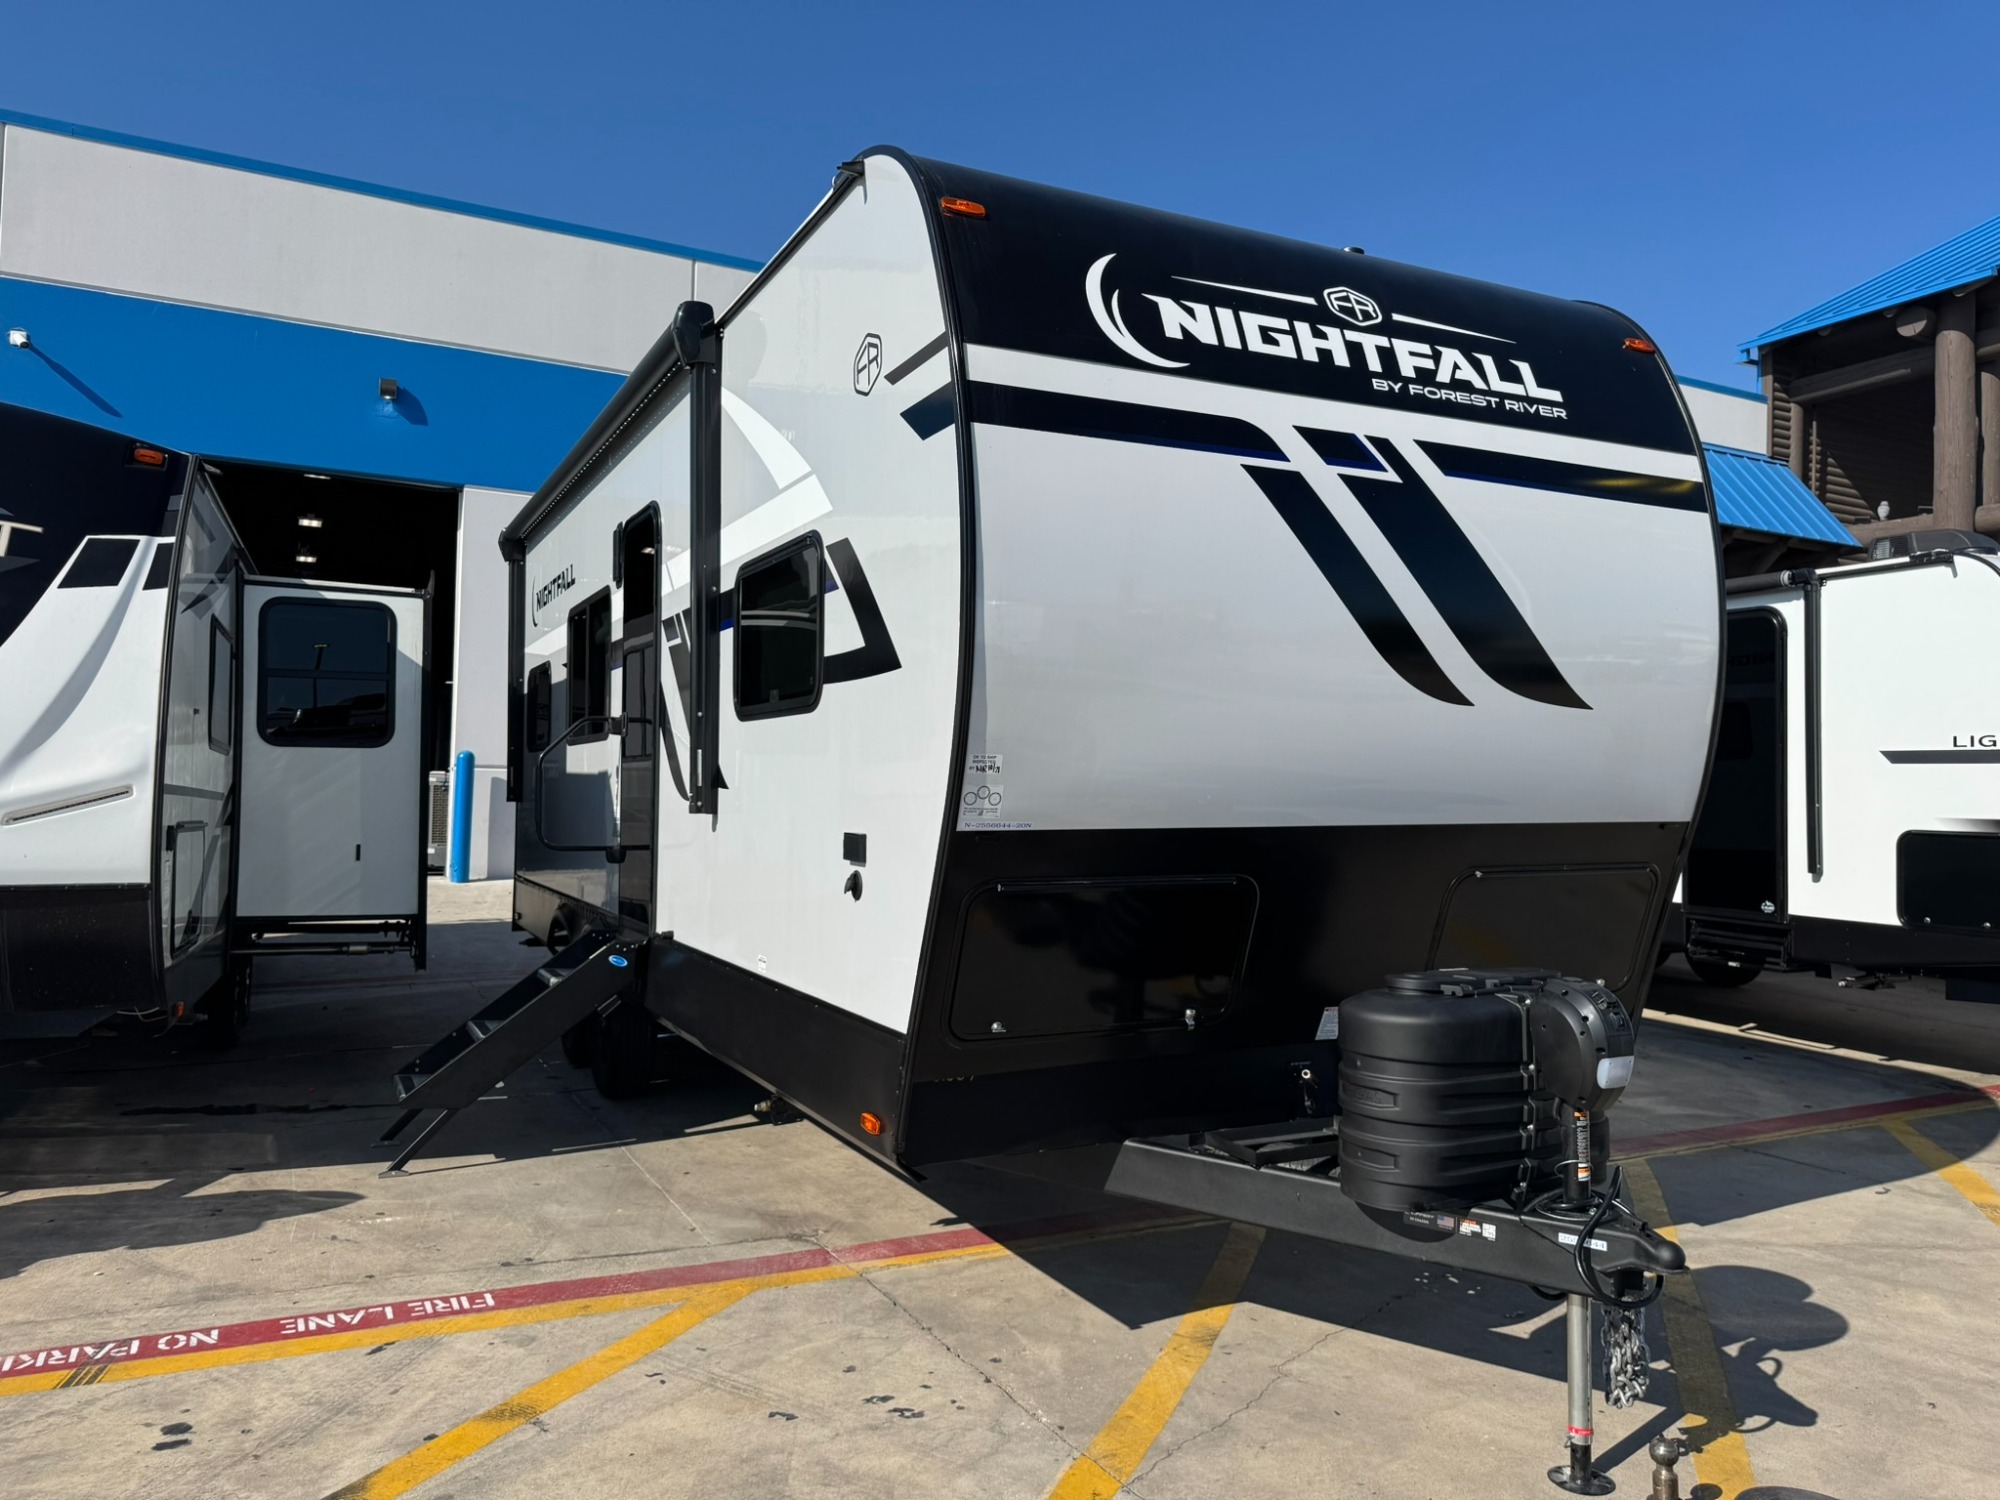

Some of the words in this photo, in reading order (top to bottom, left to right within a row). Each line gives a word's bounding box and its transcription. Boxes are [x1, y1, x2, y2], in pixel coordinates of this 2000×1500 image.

[1141, 293, 1563, 402] NIGHTFALL
[1372, 378, 1403, 393] BY
[1409, 385, 1499, 408] FOREST
[1504, 399, 1567, 419] RIVER
[536, 564, 576, 613] NIGHTFALL
[1953, 735, 1997, 748] LIG
[408, 1292, 496, 1315] FIRE
[280, 1305, 395, 1335] LANE
[157, 1328, 220, 1350] NO
